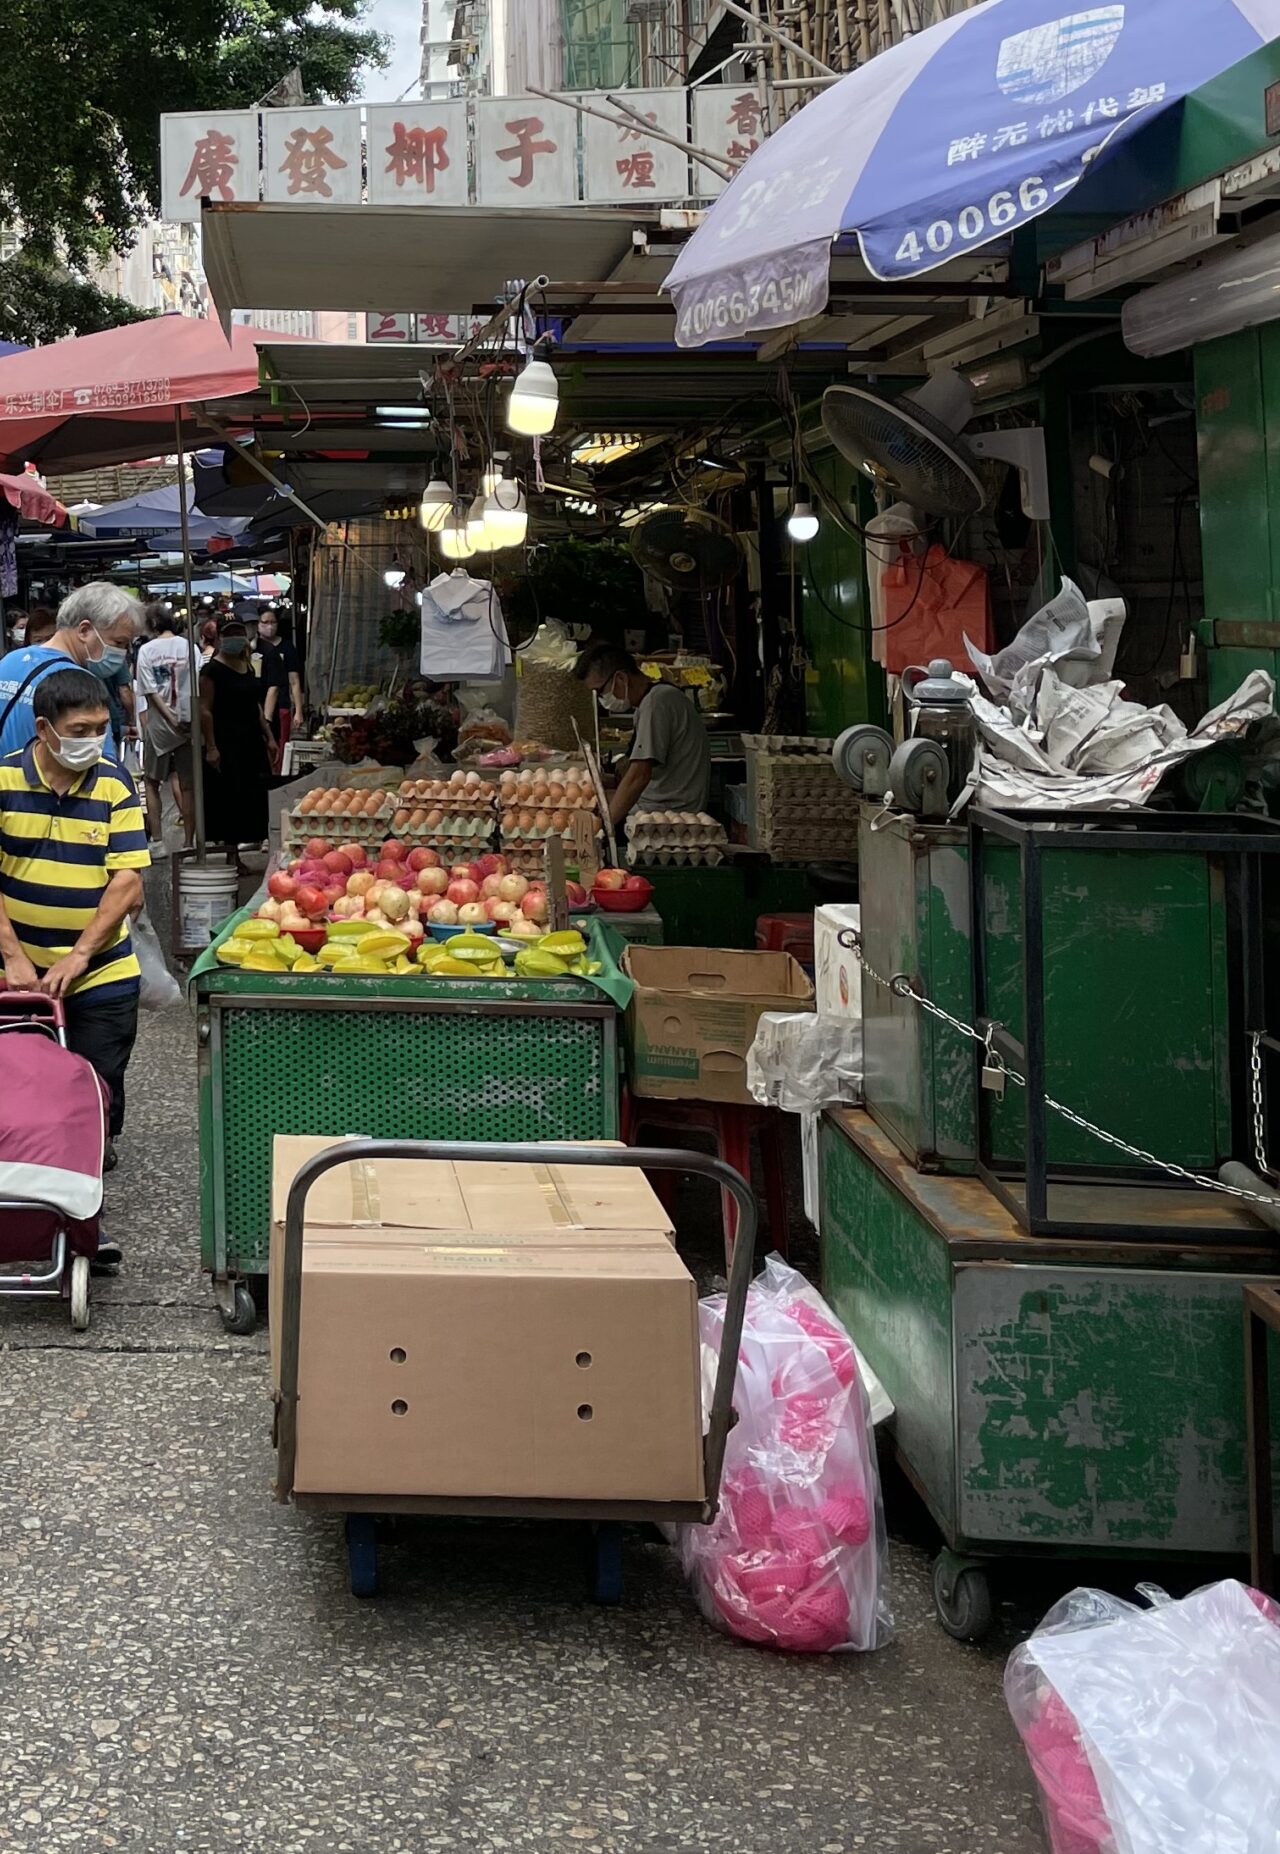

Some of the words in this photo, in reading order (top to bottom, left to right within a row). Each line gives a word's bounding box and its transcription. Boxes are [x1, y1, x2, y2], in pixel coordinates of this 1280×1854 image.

[179, 117, 557, 201] 廣發椰子
[680, 271, 815, 338] 4006634500
[646, 1044, 698, 1058] BANANA
[646, 1056, 697, 1070] Premium
